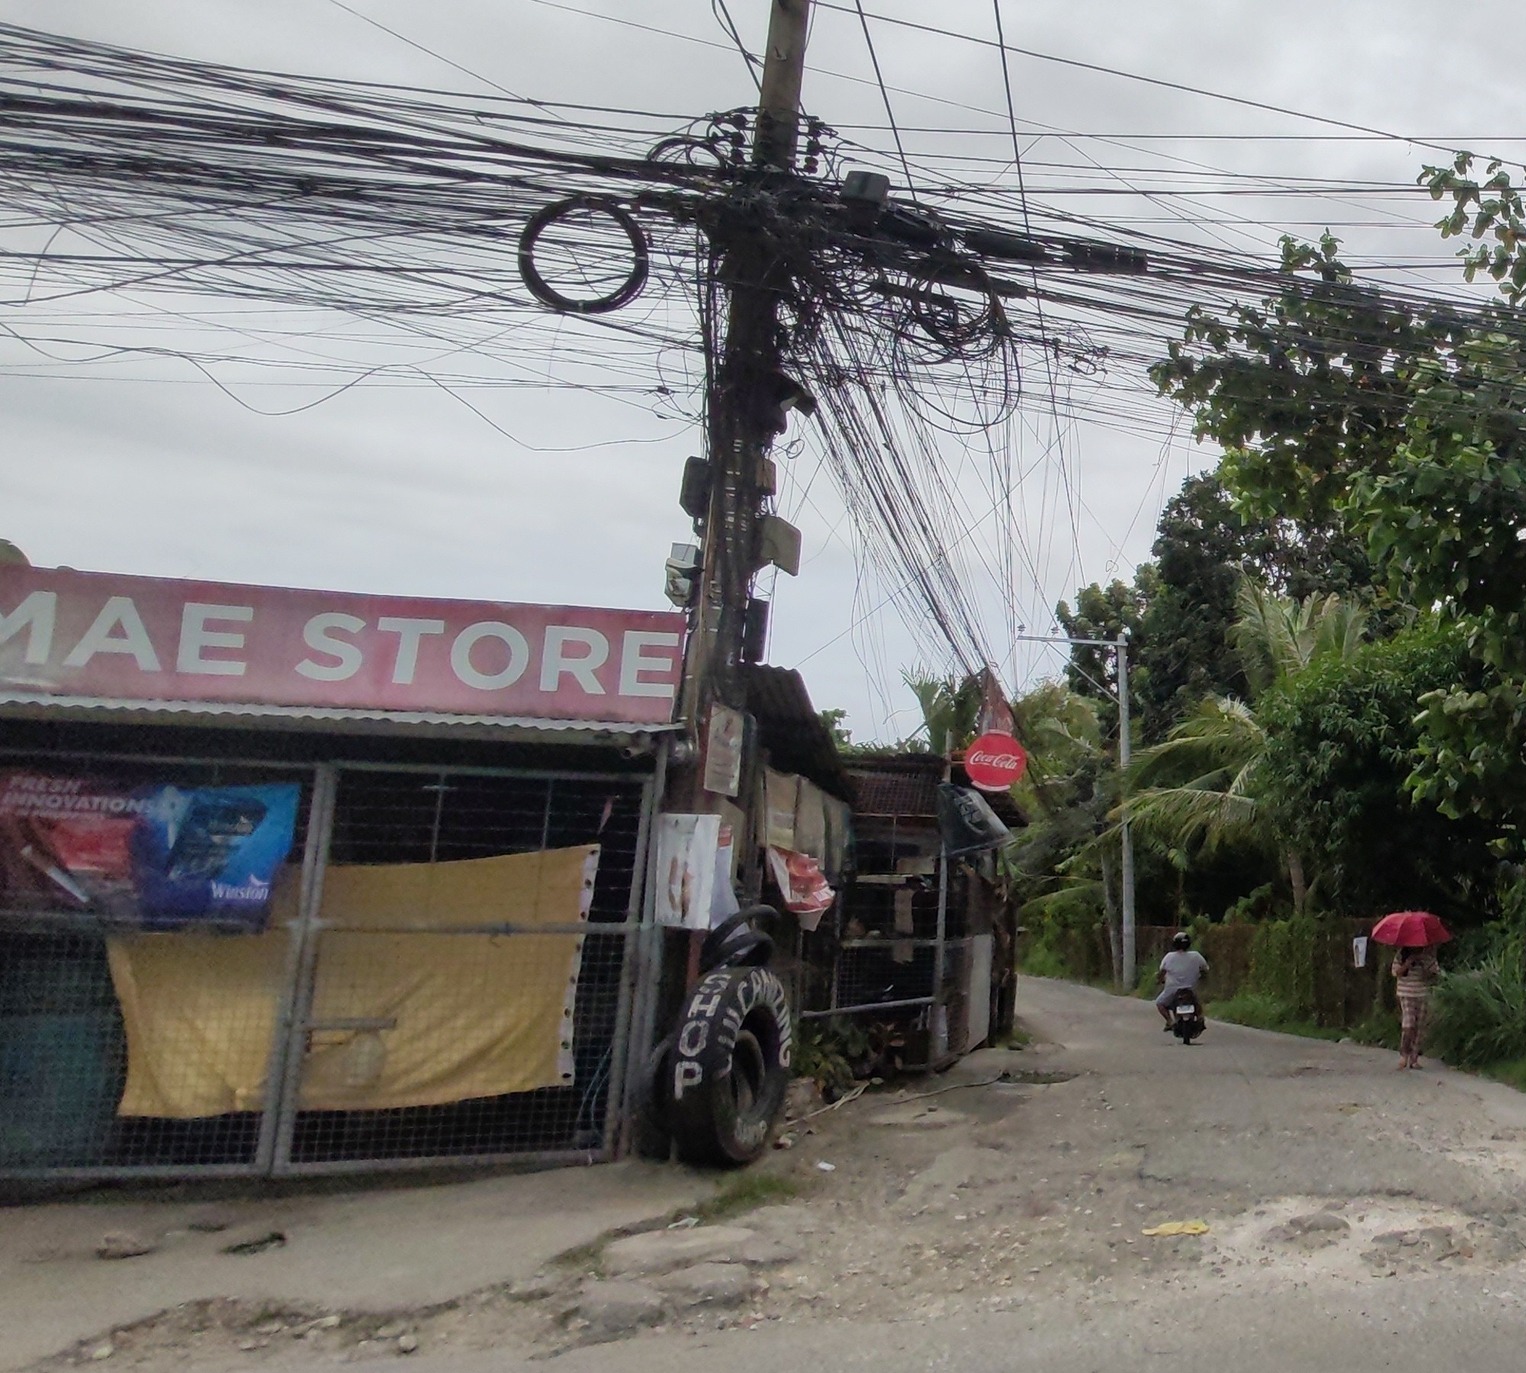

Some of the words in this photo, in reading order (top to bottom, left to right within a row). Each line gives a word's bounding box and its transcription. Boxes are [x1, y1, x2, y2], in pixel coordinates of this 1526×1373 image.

[295, 612, 680, 698] STORE
[9, 775, 82, 794] FRESH
[211, 878, 270, 901] Winston
[674, 973, 731, 1100] SHOP
